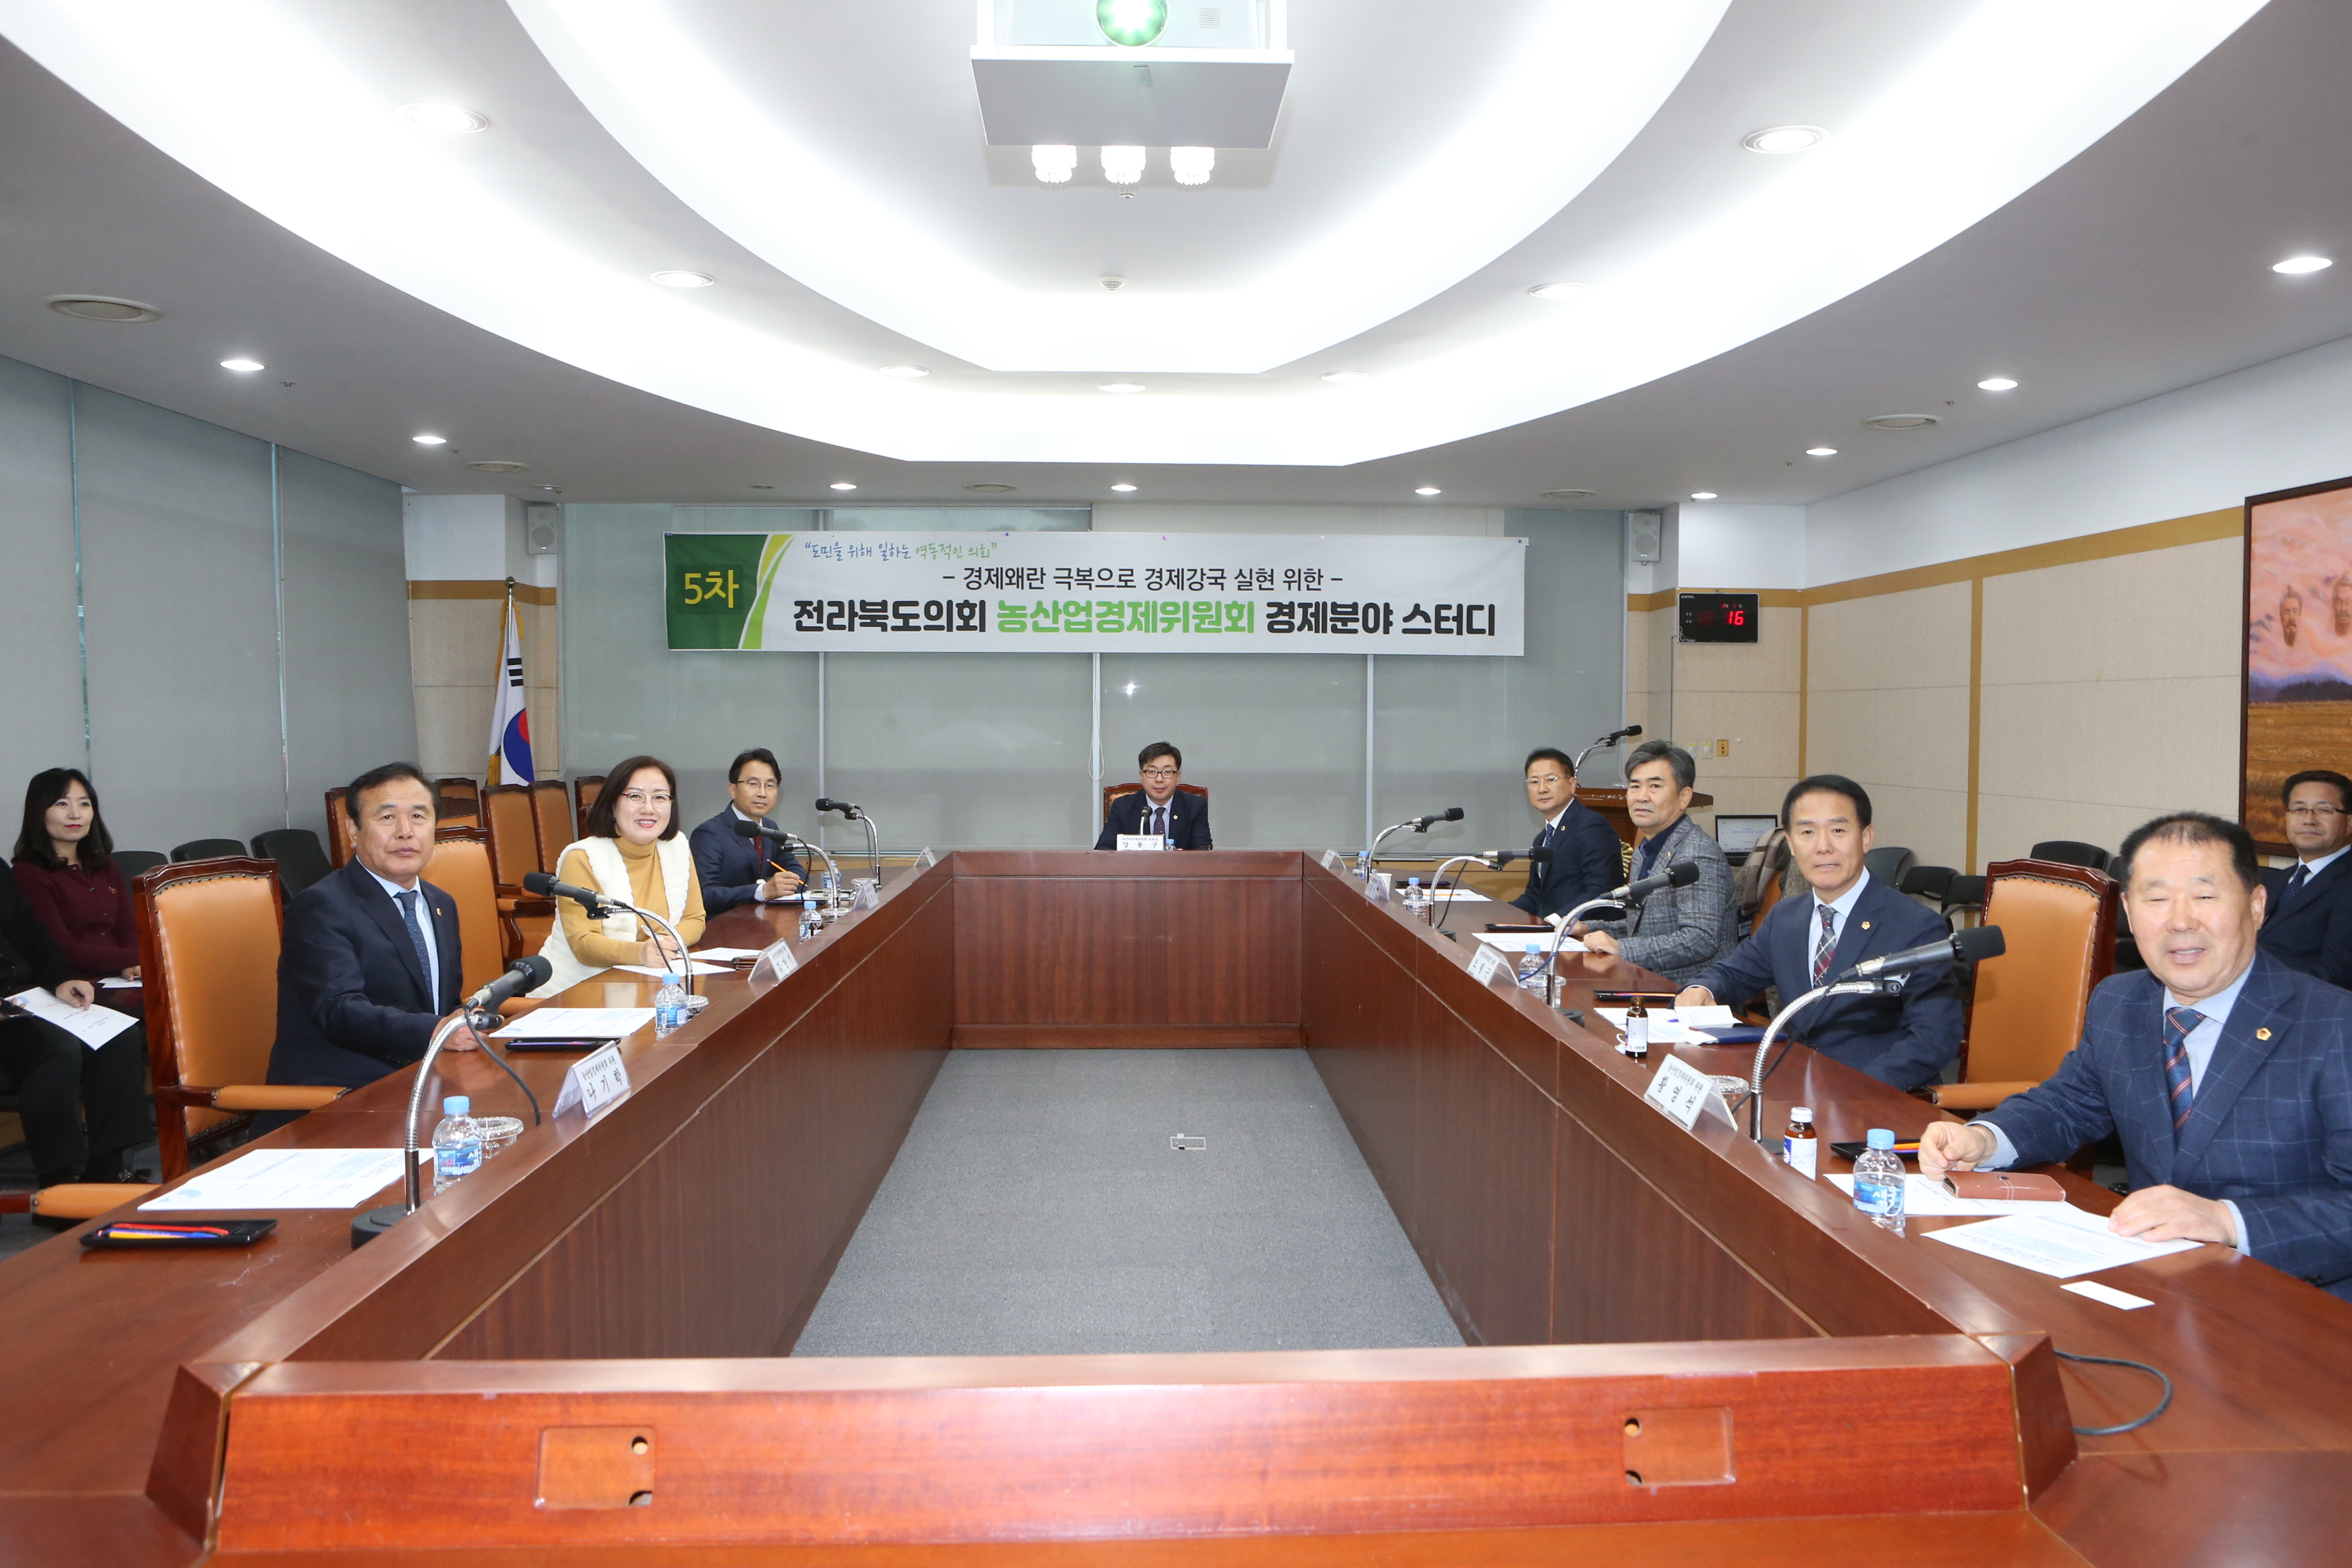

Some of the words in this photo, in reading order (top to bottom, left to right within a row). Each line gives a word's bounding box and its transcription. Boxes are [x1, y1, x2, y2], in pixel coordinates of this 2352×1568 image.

[848, 542, 873, 558] 위해
[878, 542, 911, 561] 일하는
[916, 542, 963, 561] 역동적인
[685, 570, 740, 608] 5차
[964, 567, 1047, 591] 경제왜란
[1054, 568, 1137, 591] 극복으로
[1145, 568, 1227, 591] 경제강국
[1234, 568, 1275, 591] 실현
[794, 599, 986, 633] 전라북도의회
[998, 600, 1254, 634] 농산업경제위원회
[1266, 601, 1394, 635] 경제분야
[1401, 603, 1495, 636] 스터디
[1729, 610, 1744, 625] 16
